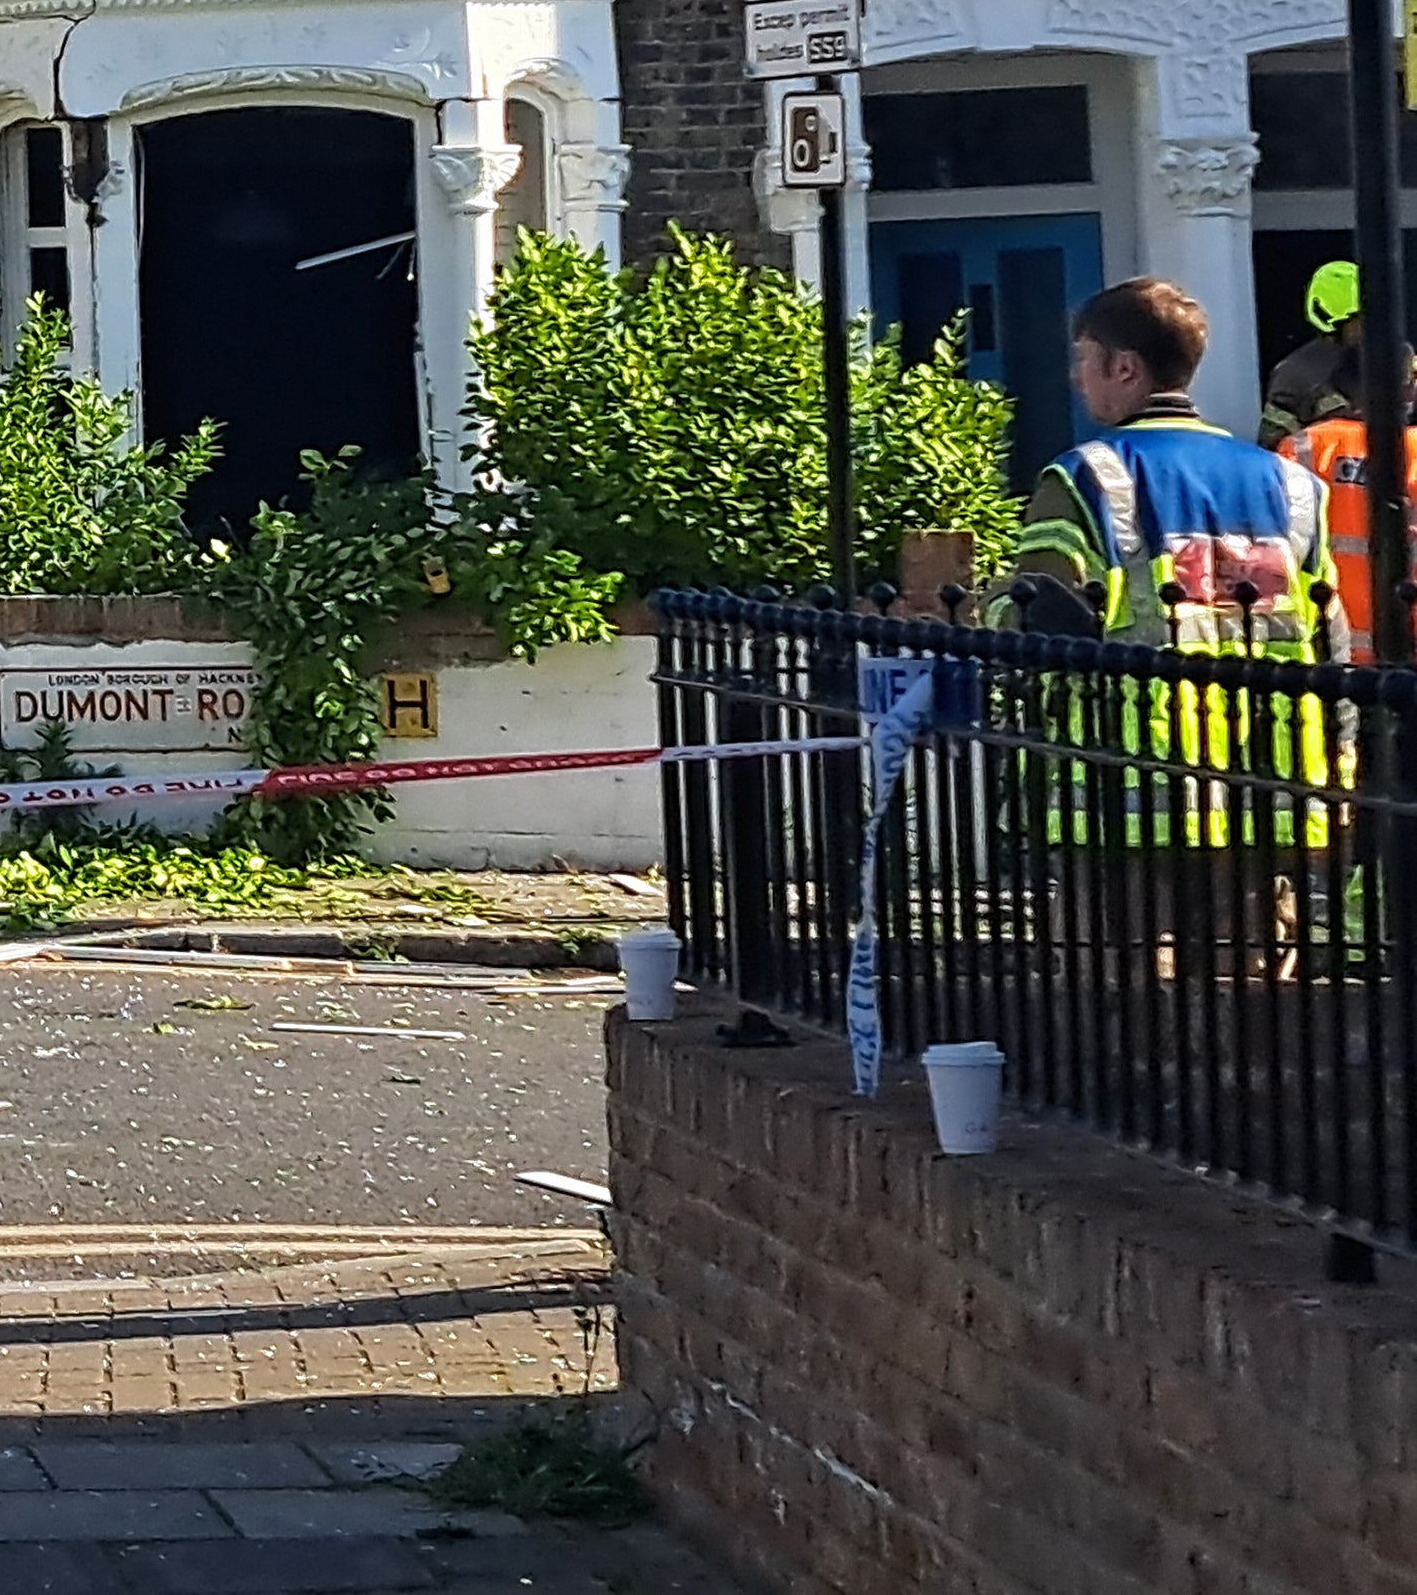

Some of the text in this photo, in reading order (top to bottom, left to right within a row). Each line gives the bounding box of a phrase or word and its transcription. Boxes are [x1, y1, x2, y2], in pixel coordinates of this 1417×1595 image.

[48, 674, 100, 686] LONDON
[107, 673, 168, 685] BOROUGH
[175, 674, 191, 685] OF
[14, 688, 245, 723] DUMONT RO
[388, 679, 429, 729] H
